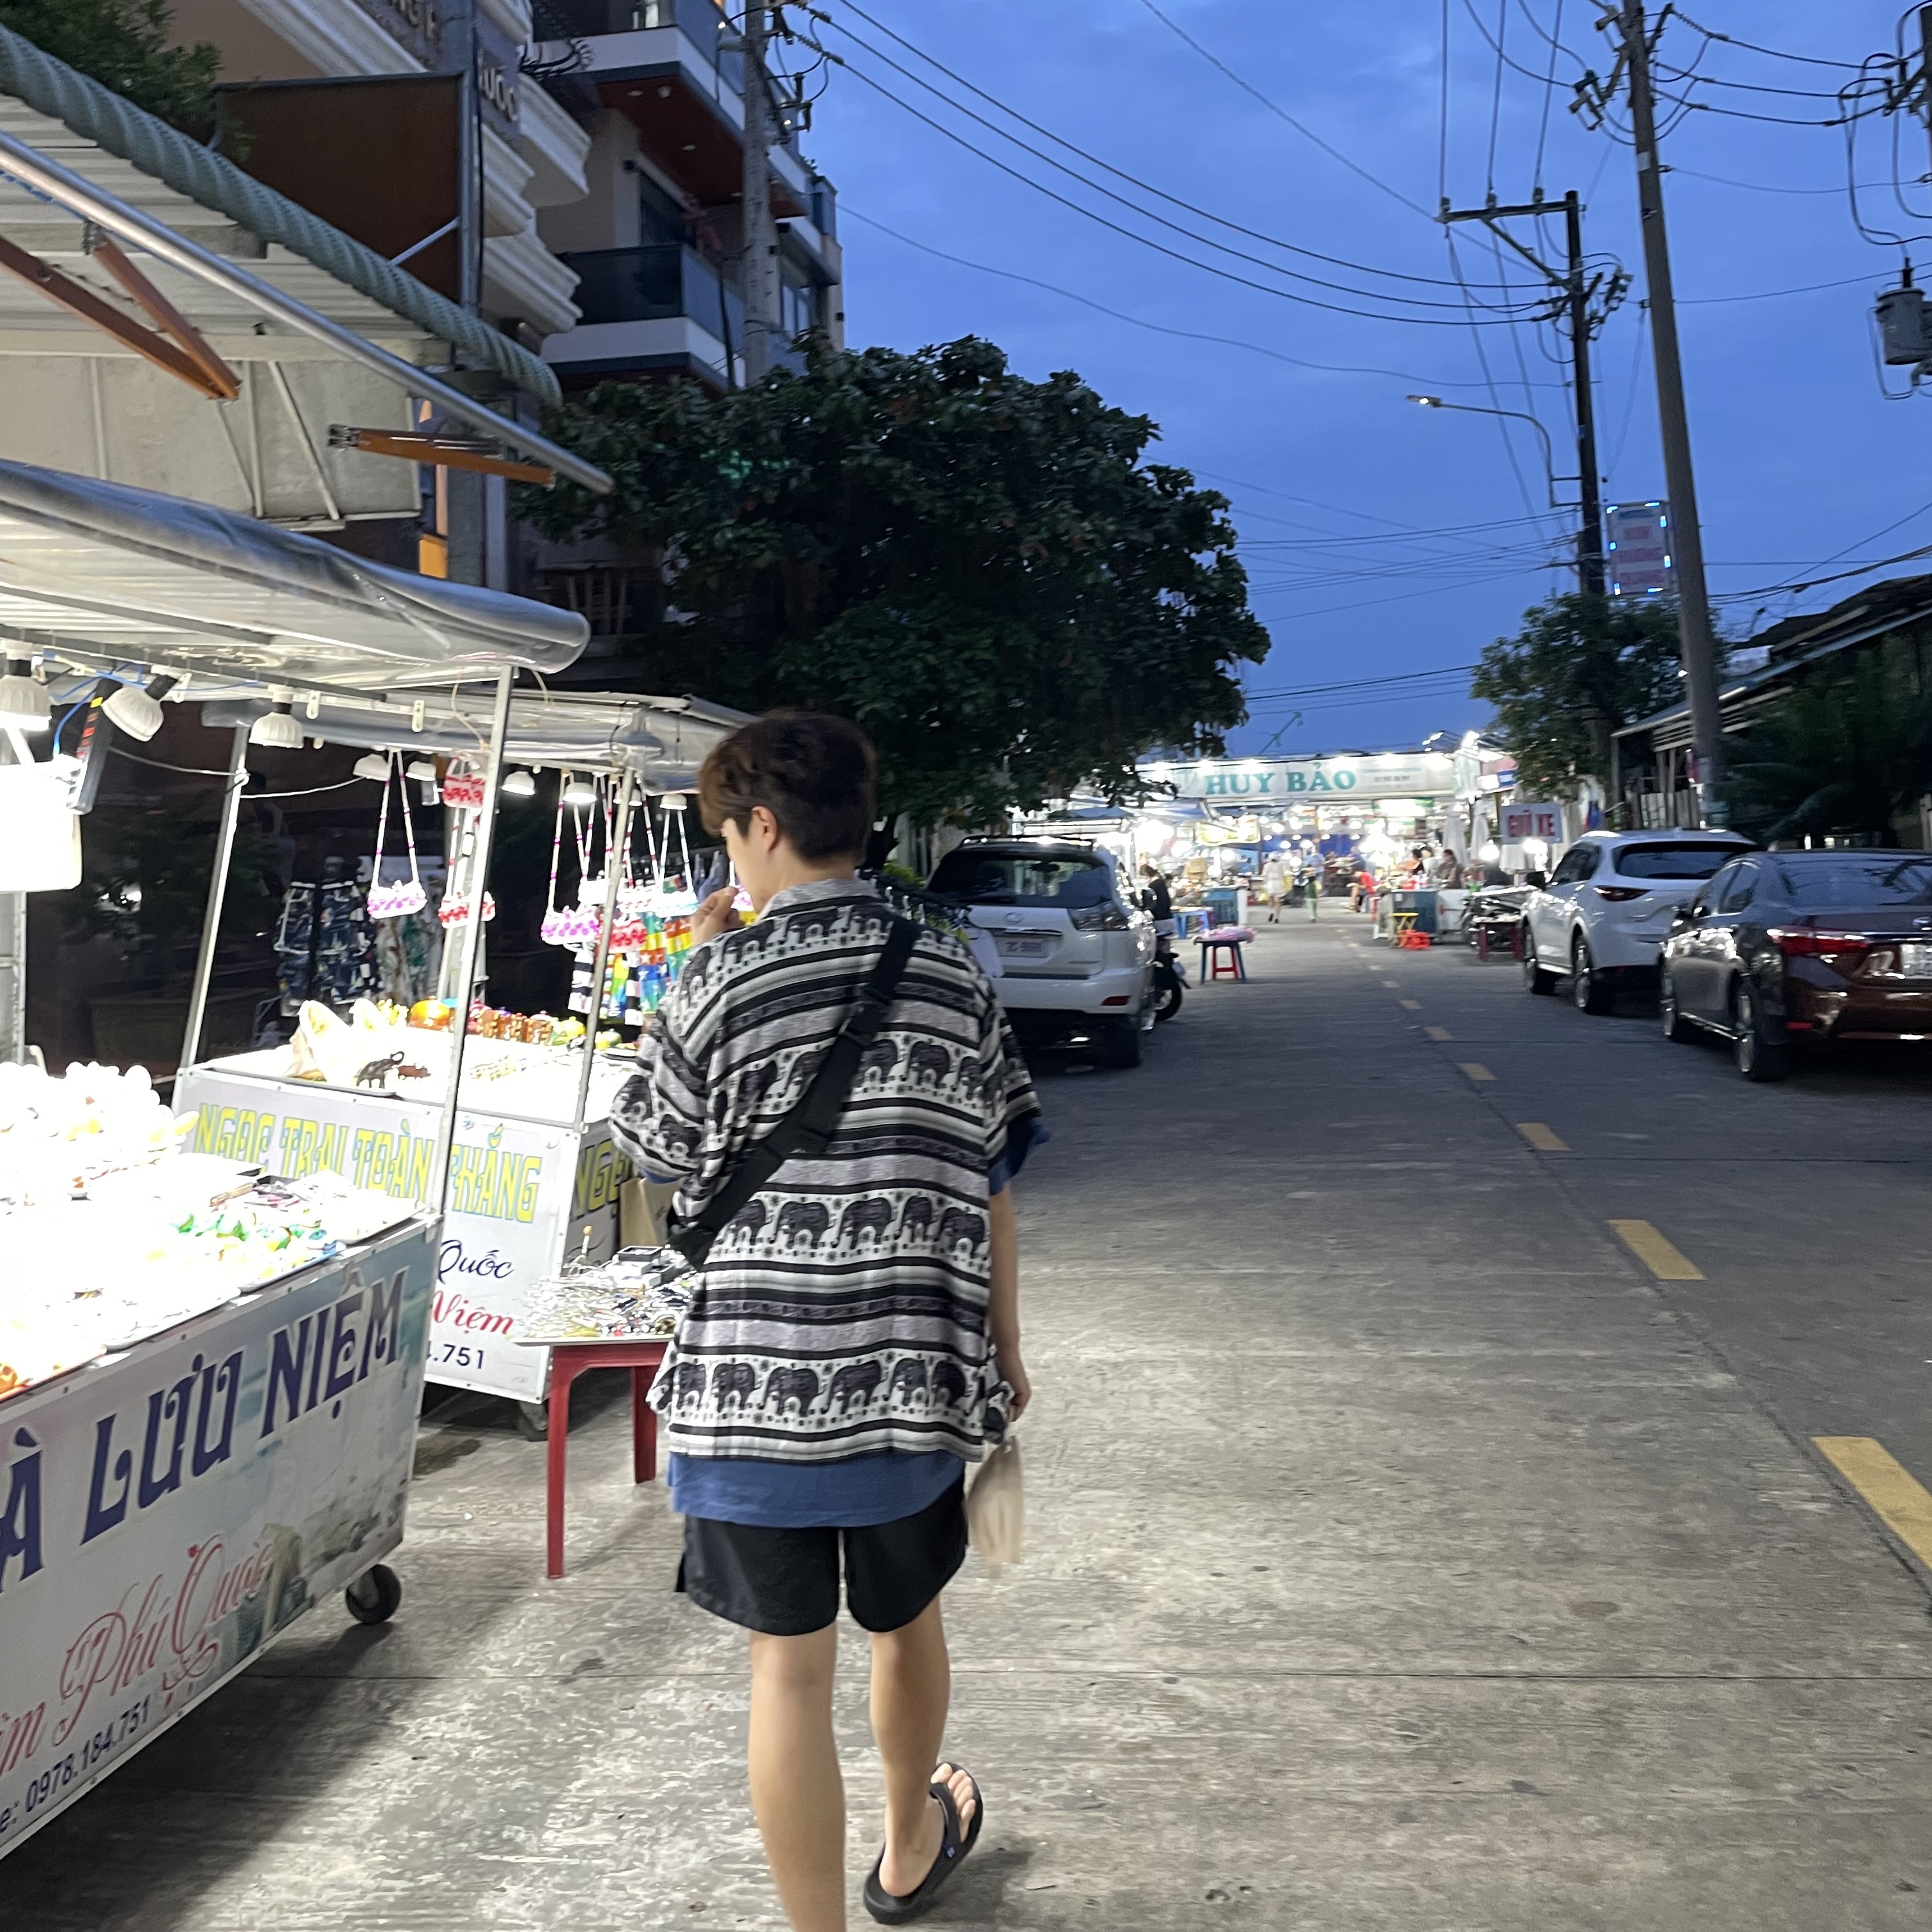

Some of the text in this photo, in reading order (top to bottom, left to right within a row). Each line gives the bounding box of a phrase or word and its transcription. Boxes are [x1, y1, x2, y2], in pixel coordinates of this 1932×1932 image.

[1204, 772, 1276, 795] HUY
[1285, 760, 1356, 793] BẢO
[279, 1116, 349, 1179] TRAI
[352, 1118, 436, 1204] TOÀN
[438, 1239, 515, 1284] Quốc
[257, 1262, 410, 1440] NIỆM
[26, 1694, 151, 1813] 0978.184.751
